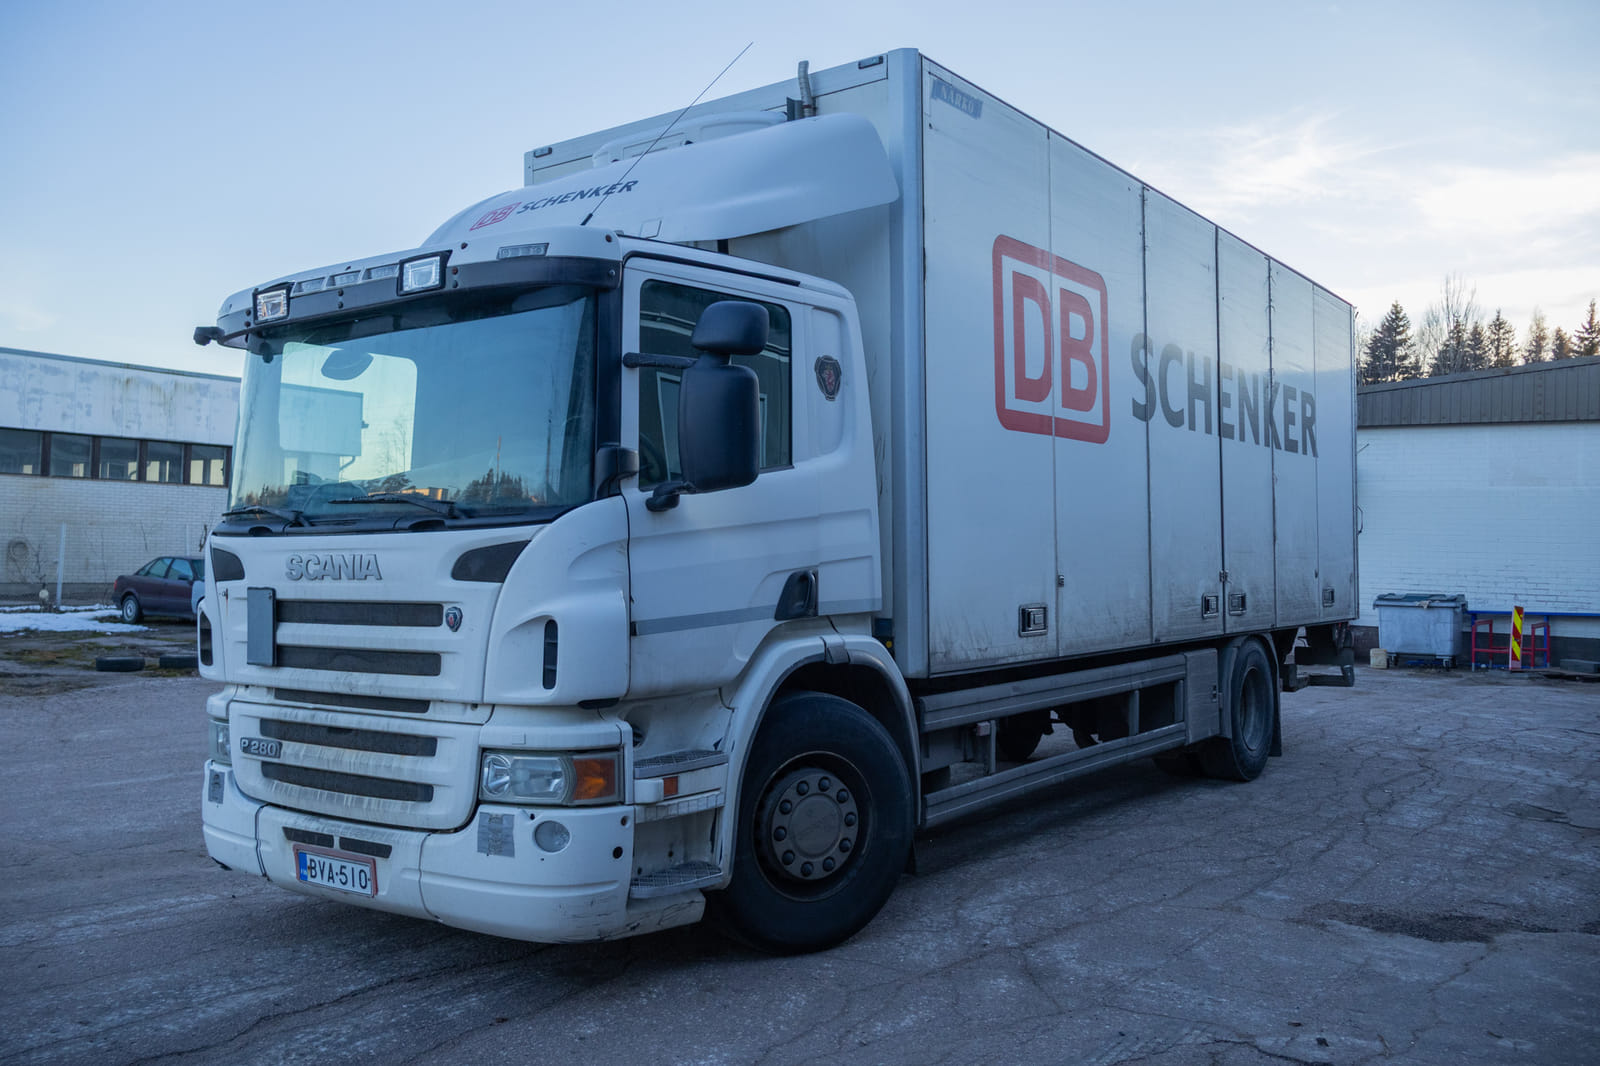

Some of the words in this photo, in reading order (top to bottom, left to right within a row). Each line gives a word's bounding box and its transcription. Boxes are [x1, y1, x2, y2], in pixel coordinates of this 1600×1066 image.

[476, 204, 519, 227] DB
[516, 180, 638, 214] SCHENKER
[1012, 270, 1097, 412] DB
[1131, 333, 1319, 458] SCHENKER
[286, 554, 383, 581] SCANIA
